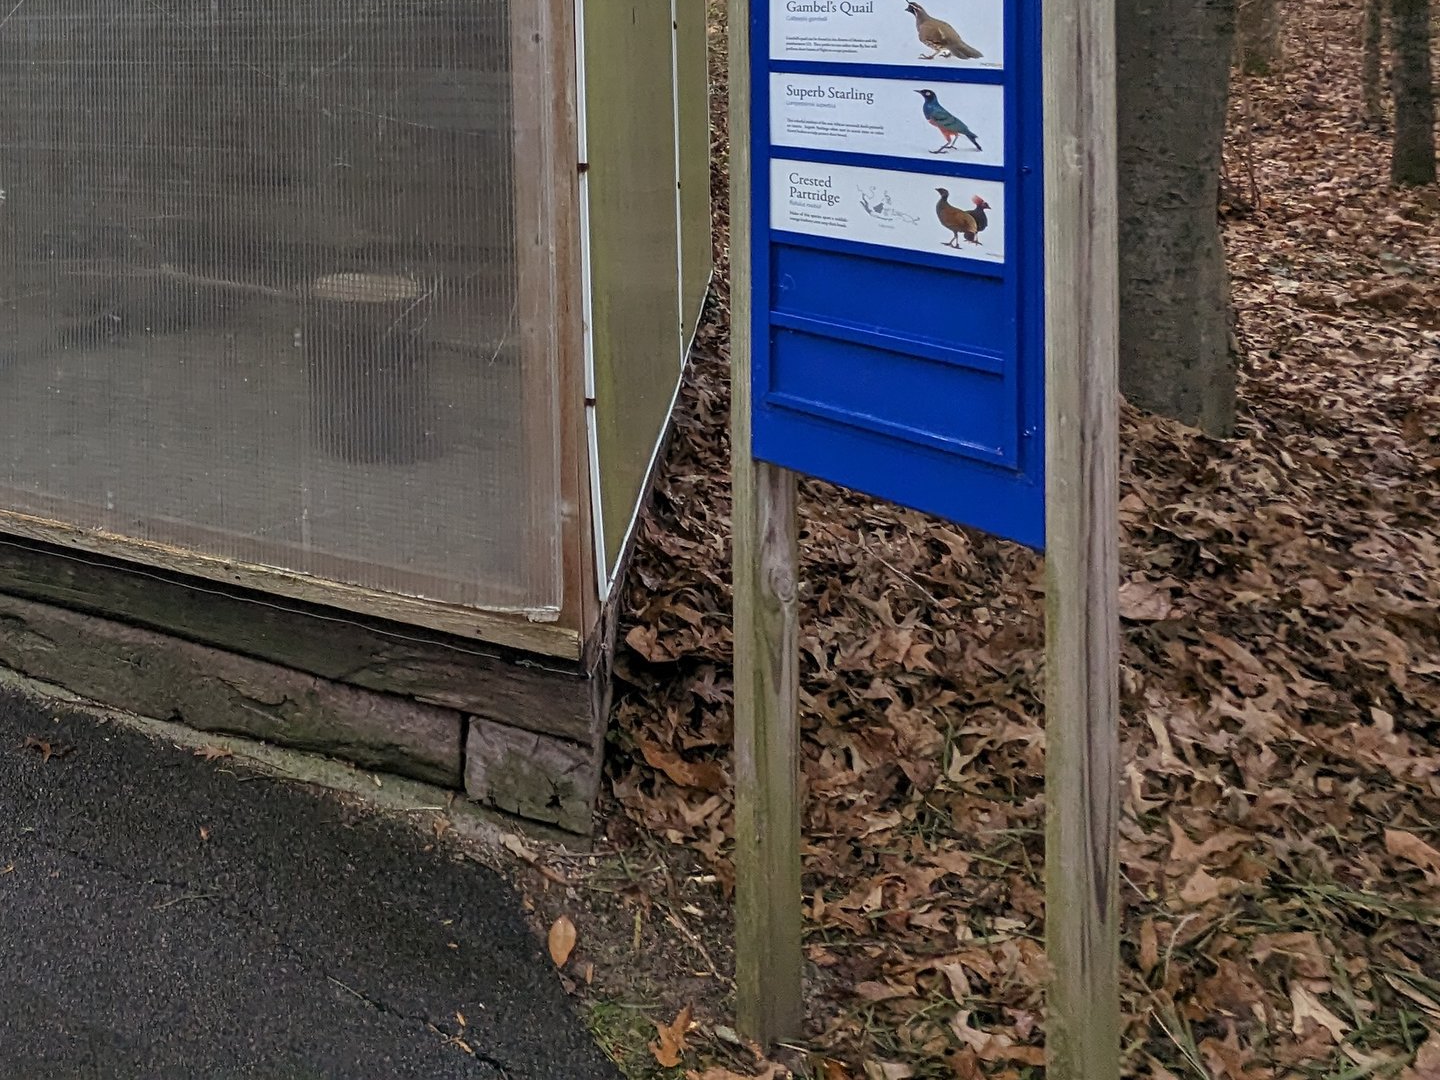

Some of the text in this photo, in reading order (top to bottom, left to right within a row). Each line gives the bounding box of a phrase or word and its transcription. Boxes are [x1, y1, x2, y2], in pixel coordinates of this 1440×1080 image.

[786, 0, 874, 17] Gambel's Quail
[786, 84, 874, 104] Superb Starling
[789, 172, 832, 188] Crested
[789, 186, 840, 206] Partridge
